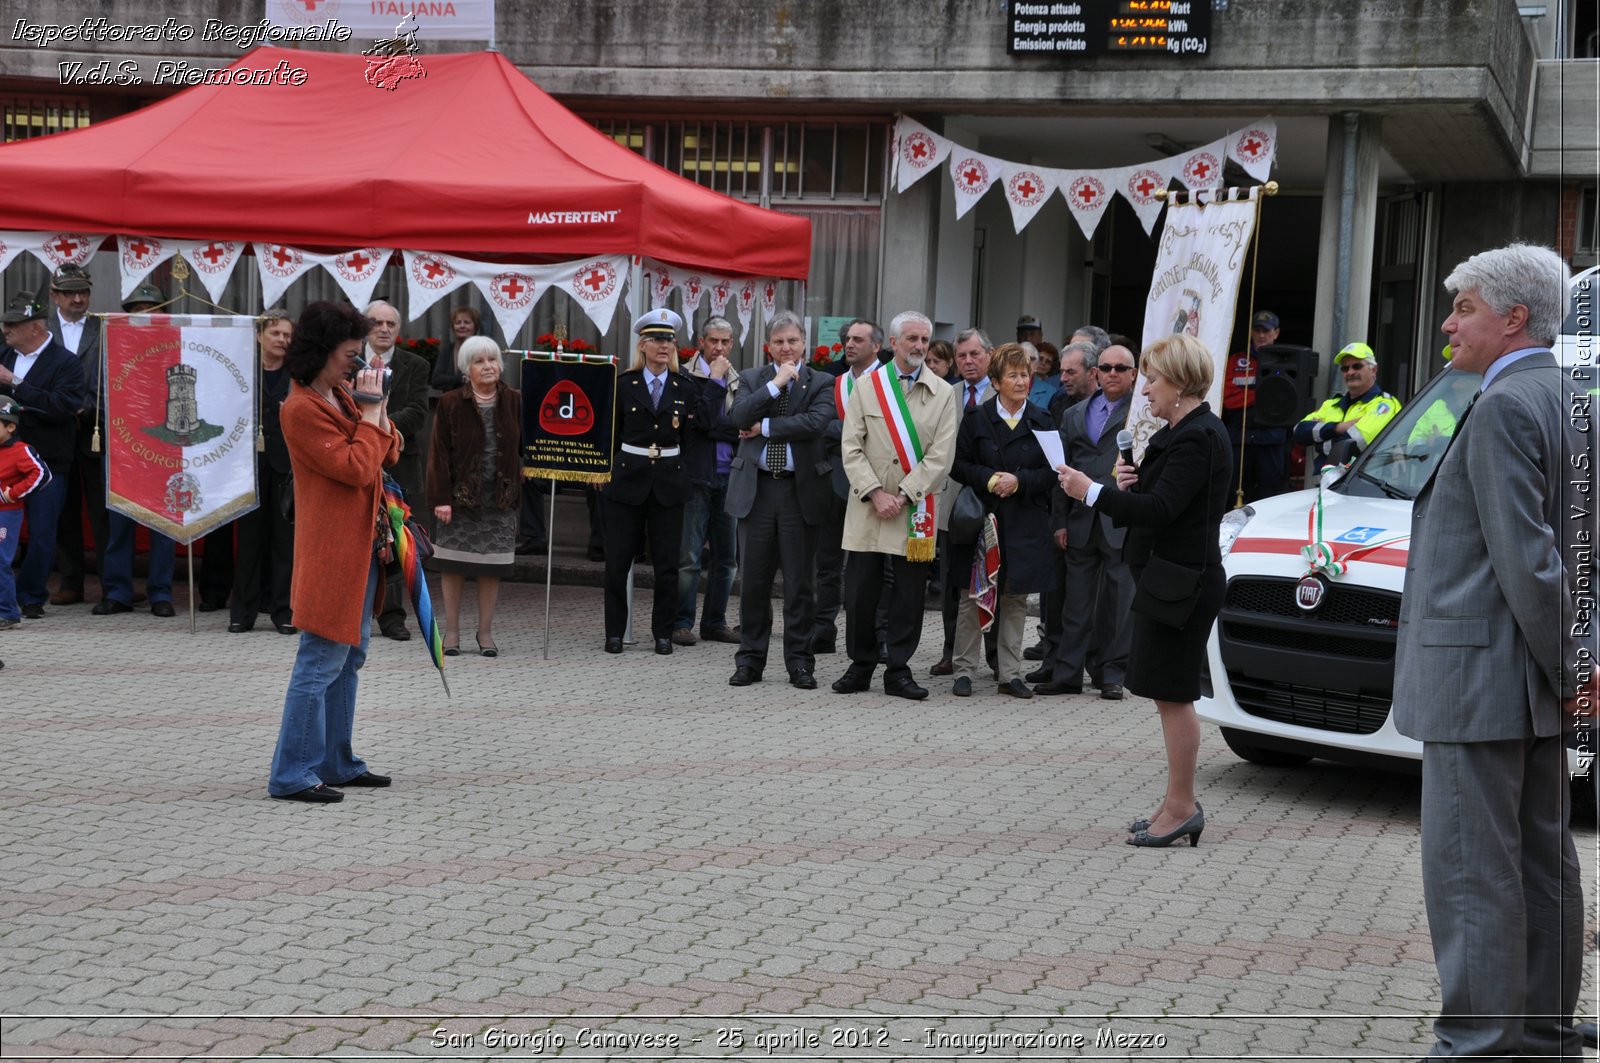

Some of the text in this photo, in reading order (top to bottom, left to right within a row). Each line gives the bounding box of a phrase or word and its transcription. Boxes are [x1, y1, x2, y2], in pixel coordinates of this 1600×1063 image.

[371, 0, 456, 17] ITALIANA
[1015, 2, 1050, 15] Potenza
[1052, 2, 1081, 15] attuale
[1170, 2, 1191, 15] Watt
[1014, 20, 1047, 35] Energia
[1049, 20, 1085, 35] prodotta
[1168, 20, 1188, 32] kWh
[1013, 37, 1054, 50] Emissioni
[1056, 38, 1086, 50] evitate
[1167, 38, 1180, 53] Kg
[528, 210, 618, 224] MASTERTENT
[112, 352, 144, 392] GRUPPO
[188, 341, 249, 394] CORTEREGGIO
[112, 416, 250, 469] SAN GIORGIO CANAVESE
[560, 440, 594, 449] COMUNALE
[531, 454, 609, 466] GIORGIO CANAVESE
[1302, 583, 1318, 601] FIAT
